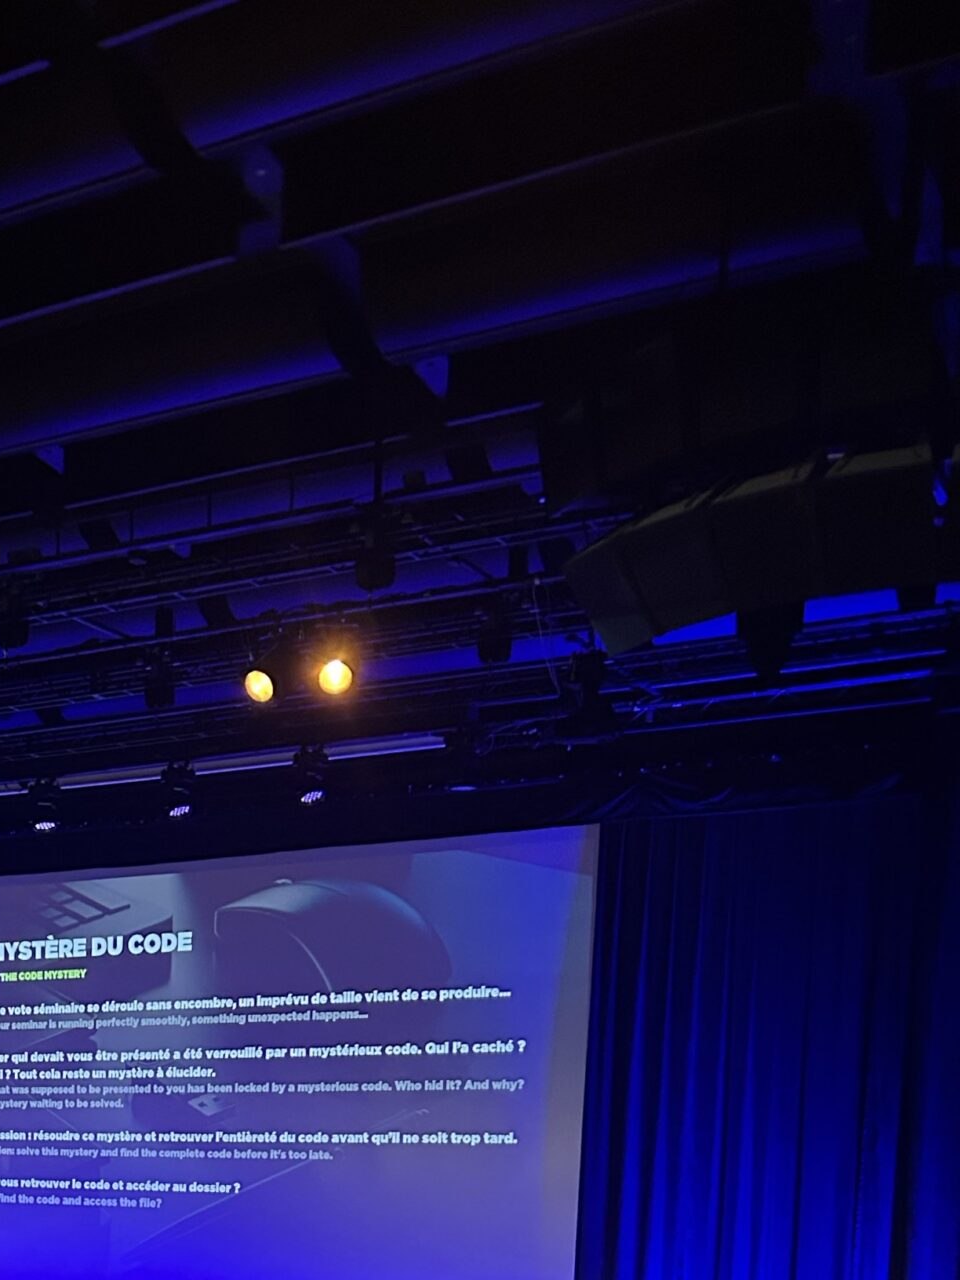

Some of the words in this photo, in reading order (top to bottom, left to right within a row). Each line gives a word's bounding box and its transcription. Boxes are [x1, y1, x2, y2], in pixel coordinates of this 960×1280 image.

[92, 936, 122, 956] DU
[128, 932, 192, 954] CODE
[0, 972, 17, 982] THE
[18, 972, 43, 981] CODE
[44, 969, 87, 980] MYSTERY
[8, 1005, 32, 1015] vote
[34, 1002, 85, 1015] séminaire
[87, 1004, 99, 1013] se
[102, 1000, 144, 1012] déroule
[147, 1001, 172, 1011] sans
[174, 997, 236, 1010] encombre,
[239, 997, 254, 1006] un
[257, 993, 308, 1007] imprévu
[311, 993, 327, 1004] de
[330, 991, 362, 1004] taille
[365, 990, 399, 1002] vient
[402, 989, 419, 1000] de
[421, 990, 437, 1000] se
[11, 1020, 47, 1030] seminar
[49, 1020, 56, 1029] is
[58, 1018, 94, 1030] running
[96, 1016, 139, 1029] perfectly
[141, 1015, 190, 1027] smoothly,
[192, 1014, 246, 1025] something
[248, 1011, 310, 1024] unexpected
[12, 1052, 28, 1064] qui
[31, 1051, 64, 1062] devait
[67, 1052, 92, 1060] vous
[95, 1050, 118, 1060] être
[121, 1049, 170, 1062] présenté
[184, 1048, 202, 1059] été
[206, 1046, 262, 1059] verrouillé
[266, 1046, 287, 1059] par
[290, 1048, 306, 1057] un
[309, 1043, 381, 1059] mystérieux
[385, 1044, 422, 1055] code.
[425, 1042, 450, 1055] Qui
[472, 1040, 514, 1053] caché
[13, 1070, 37, 1079] Tout
[39, 1069, 61, 1078] cela
[62, 1069, 90, 1078] reste
[92, 1070, 106, 1078] un
[109, 1068, 154, 1080] mystère
[156, 1068, 164, 1077] à
[166, 1066, 216, 1078] élucider.
[31, 1085, 74, 1096] supposed
[77, 1085, 86, 1094] to
[88, 1084, 100, 1094] be
[103, 1084, 151, 1096] presented
[153, 1084, 164, 1093] to
[166, 1086, 185, 1095] you
[187, 1084, 205, 1093] has
[207, 1083, 232, 1093] been
[235, 1081, 269, 1092] locked
[272, 1082, 285, 1094] by
[288, 1084, 294, 1092] a
[298, 1080, 358, 1094] mysterious
[362, 1081, 392, 1091] code.
[395, 1080, 422, 1091] Who
[425, 1080, 443, 1090] hid
[446, 1080, 461, 1090] it?
[464, 1079, 489, 1090] And
[492, 1078, 524, 1091] why?
[30, 1099, 63, 1110] waiting
[65, 1099, 74, 1108] to
[76, 1098, 88, 1108] be
[90, 1098, 124, 1108] solved.
[34, 1130, 80, 1141] résoudre
[82, 1133, 94, 1141] ce
[97, 1131, 142, 1143] mystère
[145, 1132, 156, 1141] et
[159, 1131, 214, 1142] retrouver
[280, 1132, 295, 1142] du
[298, 1132, 328, 1143] code
[331, 1133, 368, 1143] avant
[403, 1134, 419, 1143] ne
[422, 1132, 448, 1144] soit
[451, 1133, 481, 1146] trop
[484, 1132, 517, 1144] tard.
[16, 1147, 39, 1156] solve
[42, 1147, 58, 1156] this
[60, 1147, 98, 1158] mystery
[100, 1147, 118, 1157] and
[120, 1147, 139, 1157] find
[141, 1148, 157, 1158] the
[159, 1149, 205, 1160] complete
[207, 1149, 231, 1158] code
[234, 1149, 268, 1159] before
[289, 1151, 307, 1159] too
[309, 1149, 333, 1160] late.
[20, 1178, 70, 1189] retrouver
[72, 1179, 82, 1189] le
[84, 1180, 110, 1190] code
[112, 1181, 123, 1190] et
[126, 1181, 170, 1191] accéder
[172, 1184, 186, 1192] au
[189, 1182, 231, 1193] dossier
[18, 1194, 34, 1204] the
[36, 1195, 60, 1205] code
[62, 1196, 81, 1206] and
[83, 1198, 117, 1207] access
[119, 1197, 137, 1207] the
[139, 1197, 162, 1208] file?
